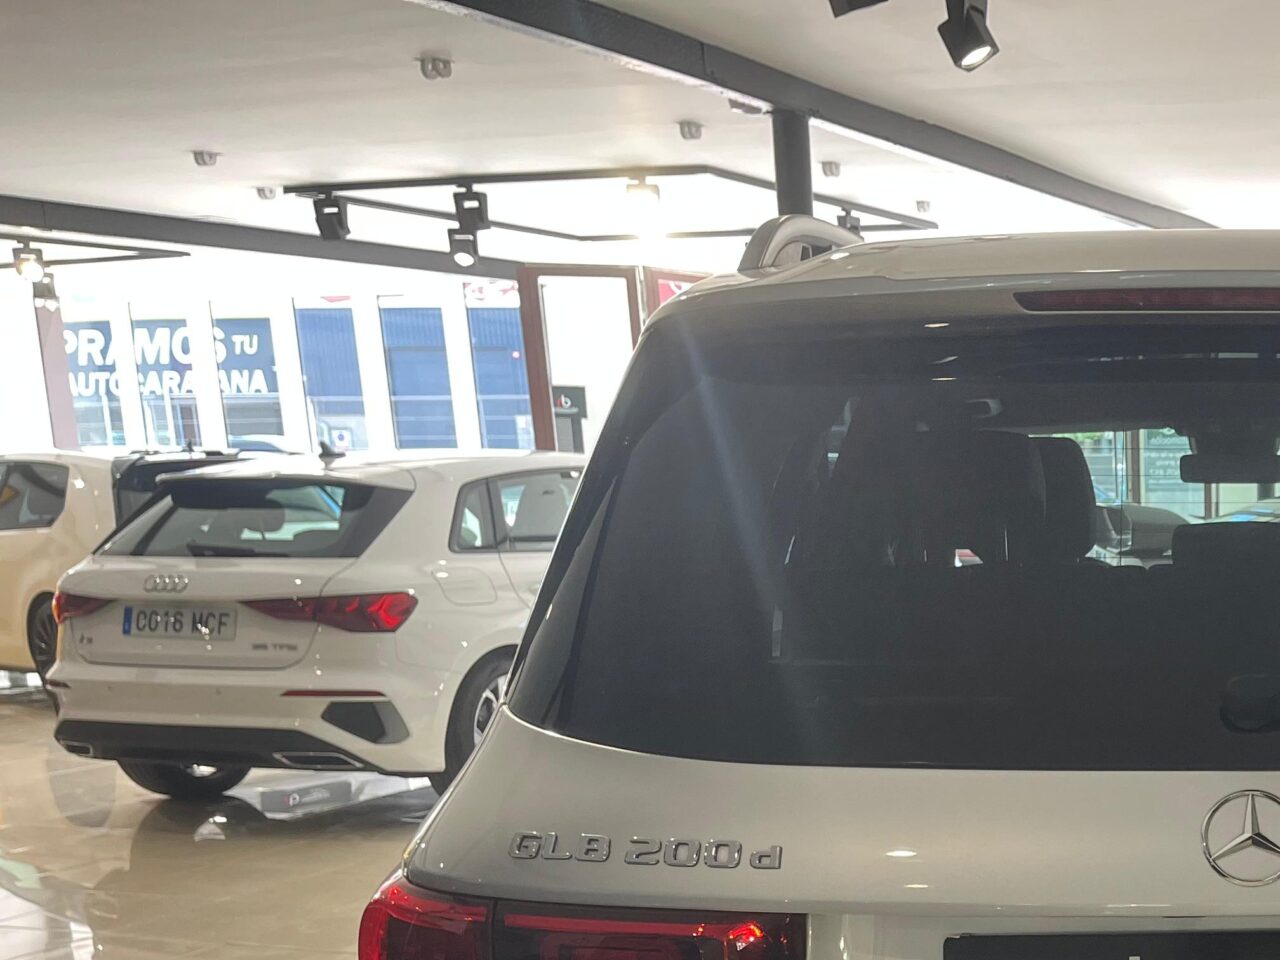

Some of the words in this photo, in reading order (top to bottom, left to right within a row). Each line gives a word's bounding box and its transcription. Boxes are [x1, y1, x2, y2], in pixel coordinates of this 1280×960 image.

[63, 327, 227, 366] PRMOS
[232, 334, 258, 355] TU
[508, 831, 612, 862] GLB
[624, 837, 742, 868] 200
[750, 845, 782, 869] d
